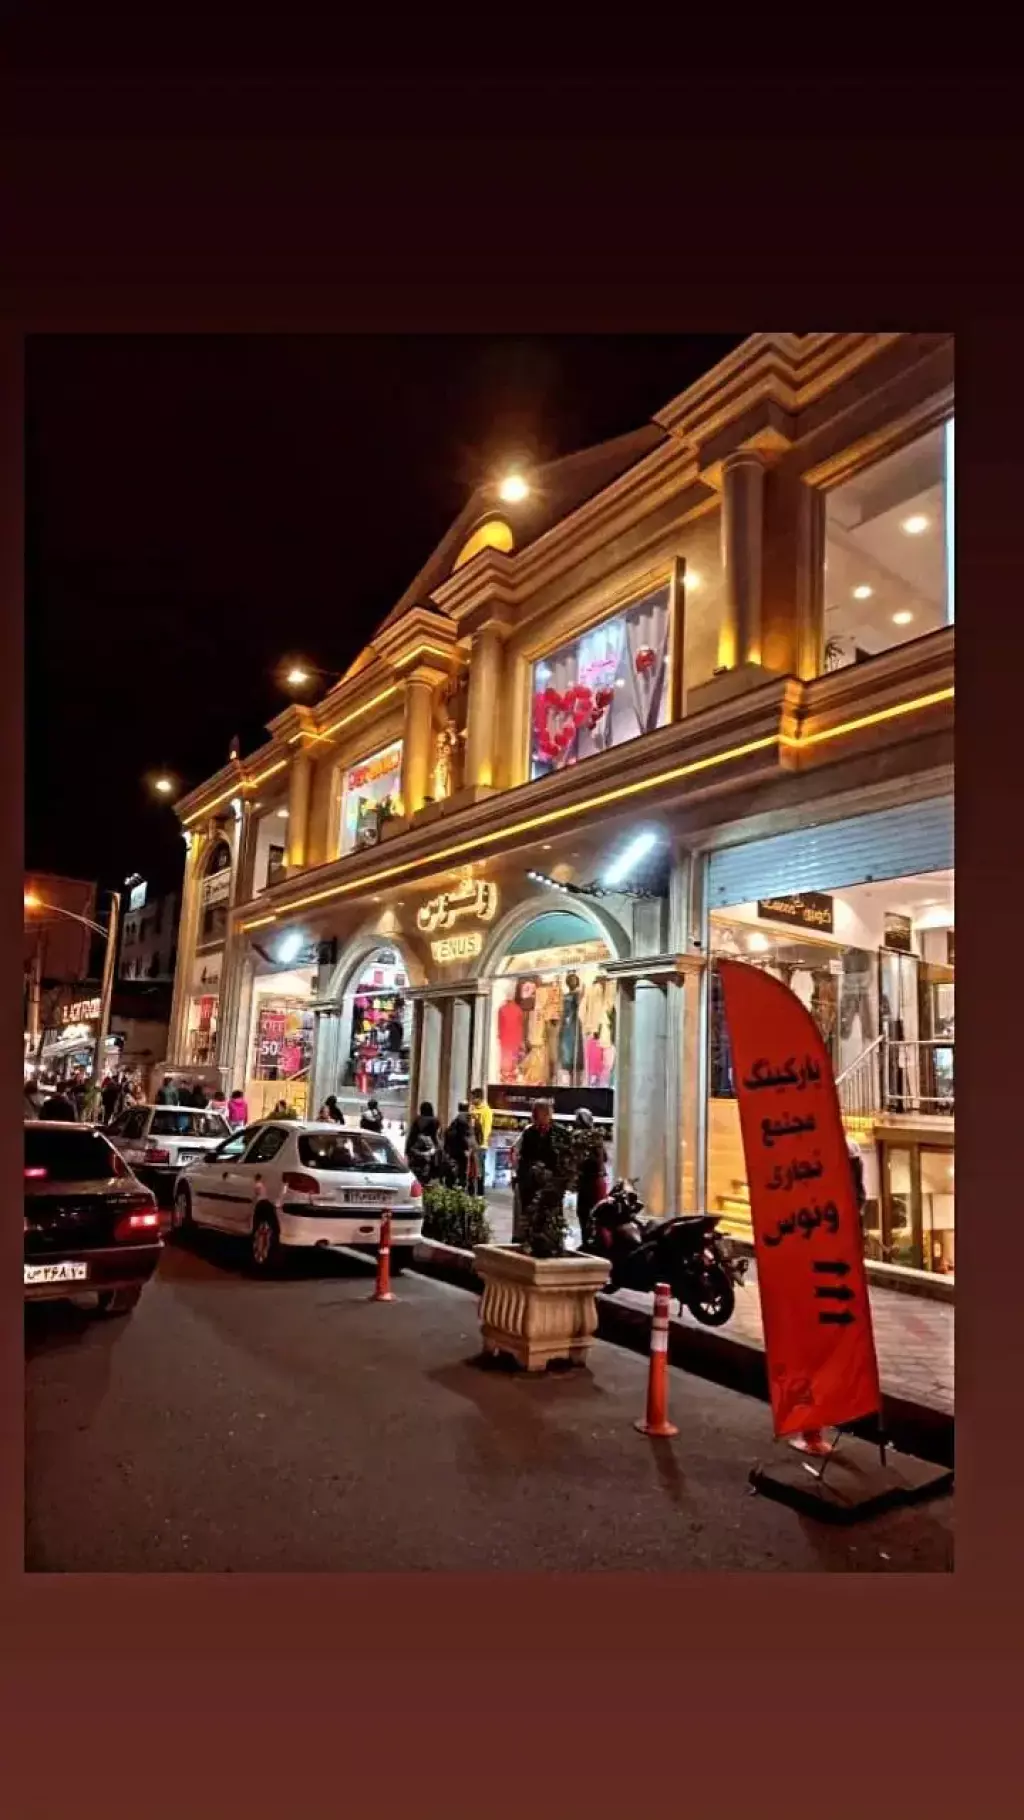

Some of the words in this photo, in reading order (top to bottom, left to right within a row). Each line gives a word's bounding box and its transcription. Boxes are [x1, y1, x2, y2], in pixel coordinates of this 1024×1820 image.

[743, 1054, 821, 1093] پارکینگ
[761, 1110, 816, 1147] مجتمع
[765, 1148, 823, 1191] تجاری
[763, 1198, 840, 1247] ونوس
